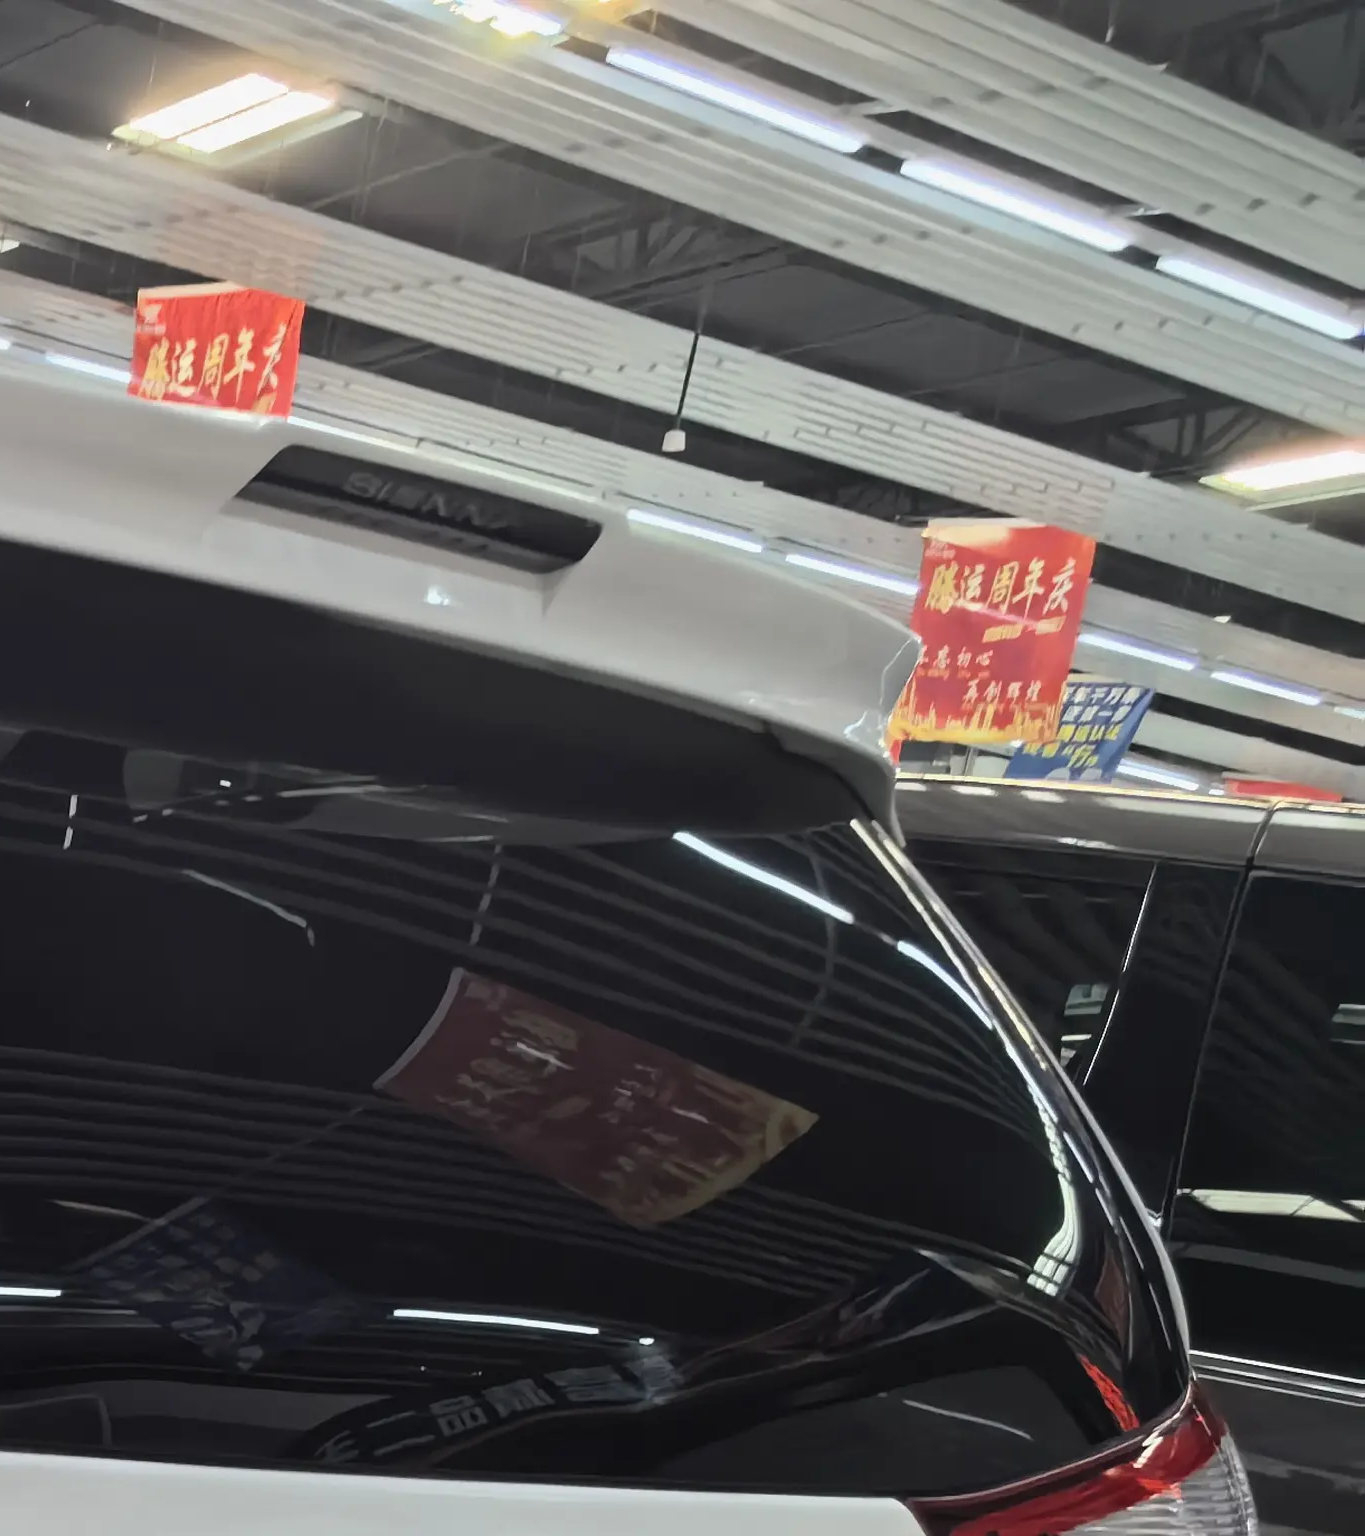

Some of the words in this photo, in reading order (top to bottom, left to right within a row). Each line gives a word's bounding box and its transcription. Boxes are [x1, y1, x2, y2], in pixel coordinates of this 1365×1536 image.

[924, 556, 1076, 619] 腾运周年庆
